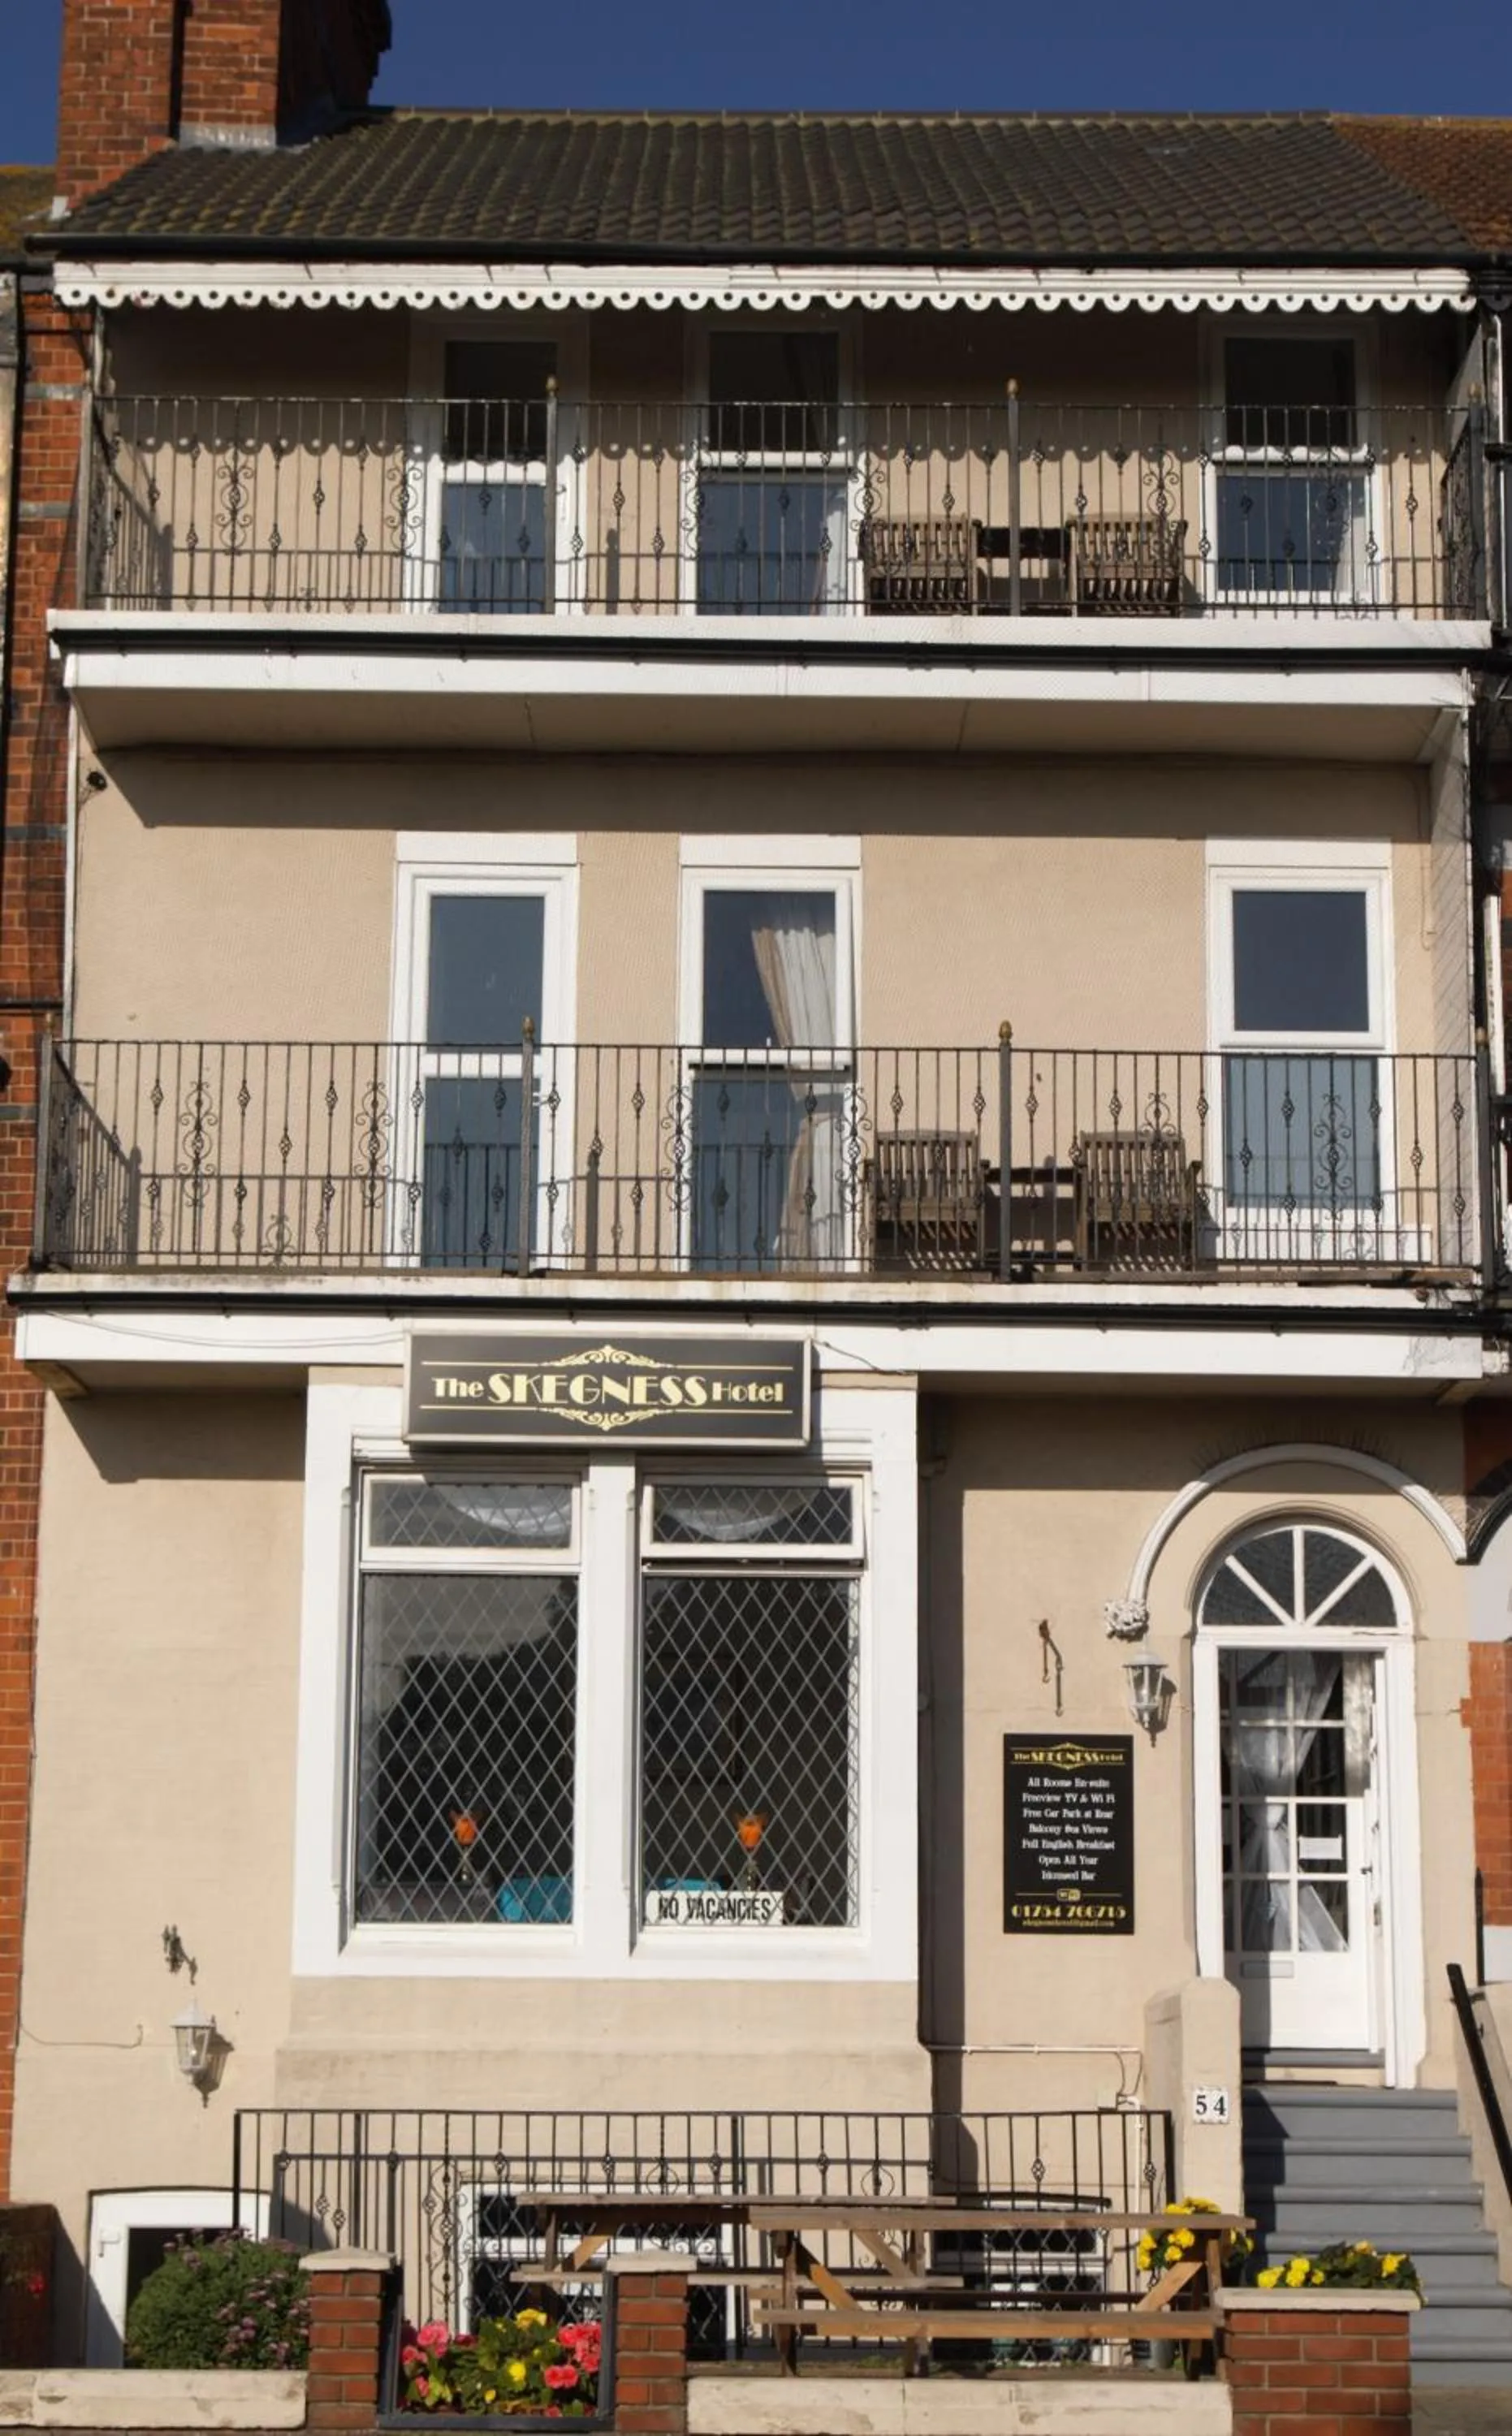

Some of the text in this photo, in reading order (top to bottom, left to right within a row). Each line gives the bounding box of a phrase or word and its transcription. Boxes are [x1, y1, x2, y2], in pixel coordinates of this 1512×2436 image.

[433, 1373, 784, 1406] The SKEGNESS Hotel
[1027, 1777, 1040, 1787] All
[1043, 1777, 1072, 1787] Rooms
[1065, 1793, 1078, 1803] TV
[1080, 1794, 1088, 1803] &
[1022, 1808, 1042, 1818] Free
[1043, 1808, 1059, 1818] Car
[1062, 1808, 1081, 1818] Park
[1095, 1808, 1114, 1819] Rear
[1022, 1839, 1039, 1849] Full
[1042, 1839, 1074, 1851] English
[1039, 1854, 1099, 1867] Open All Year
[659, 1897, 771, 1920] NO VACANCIES
